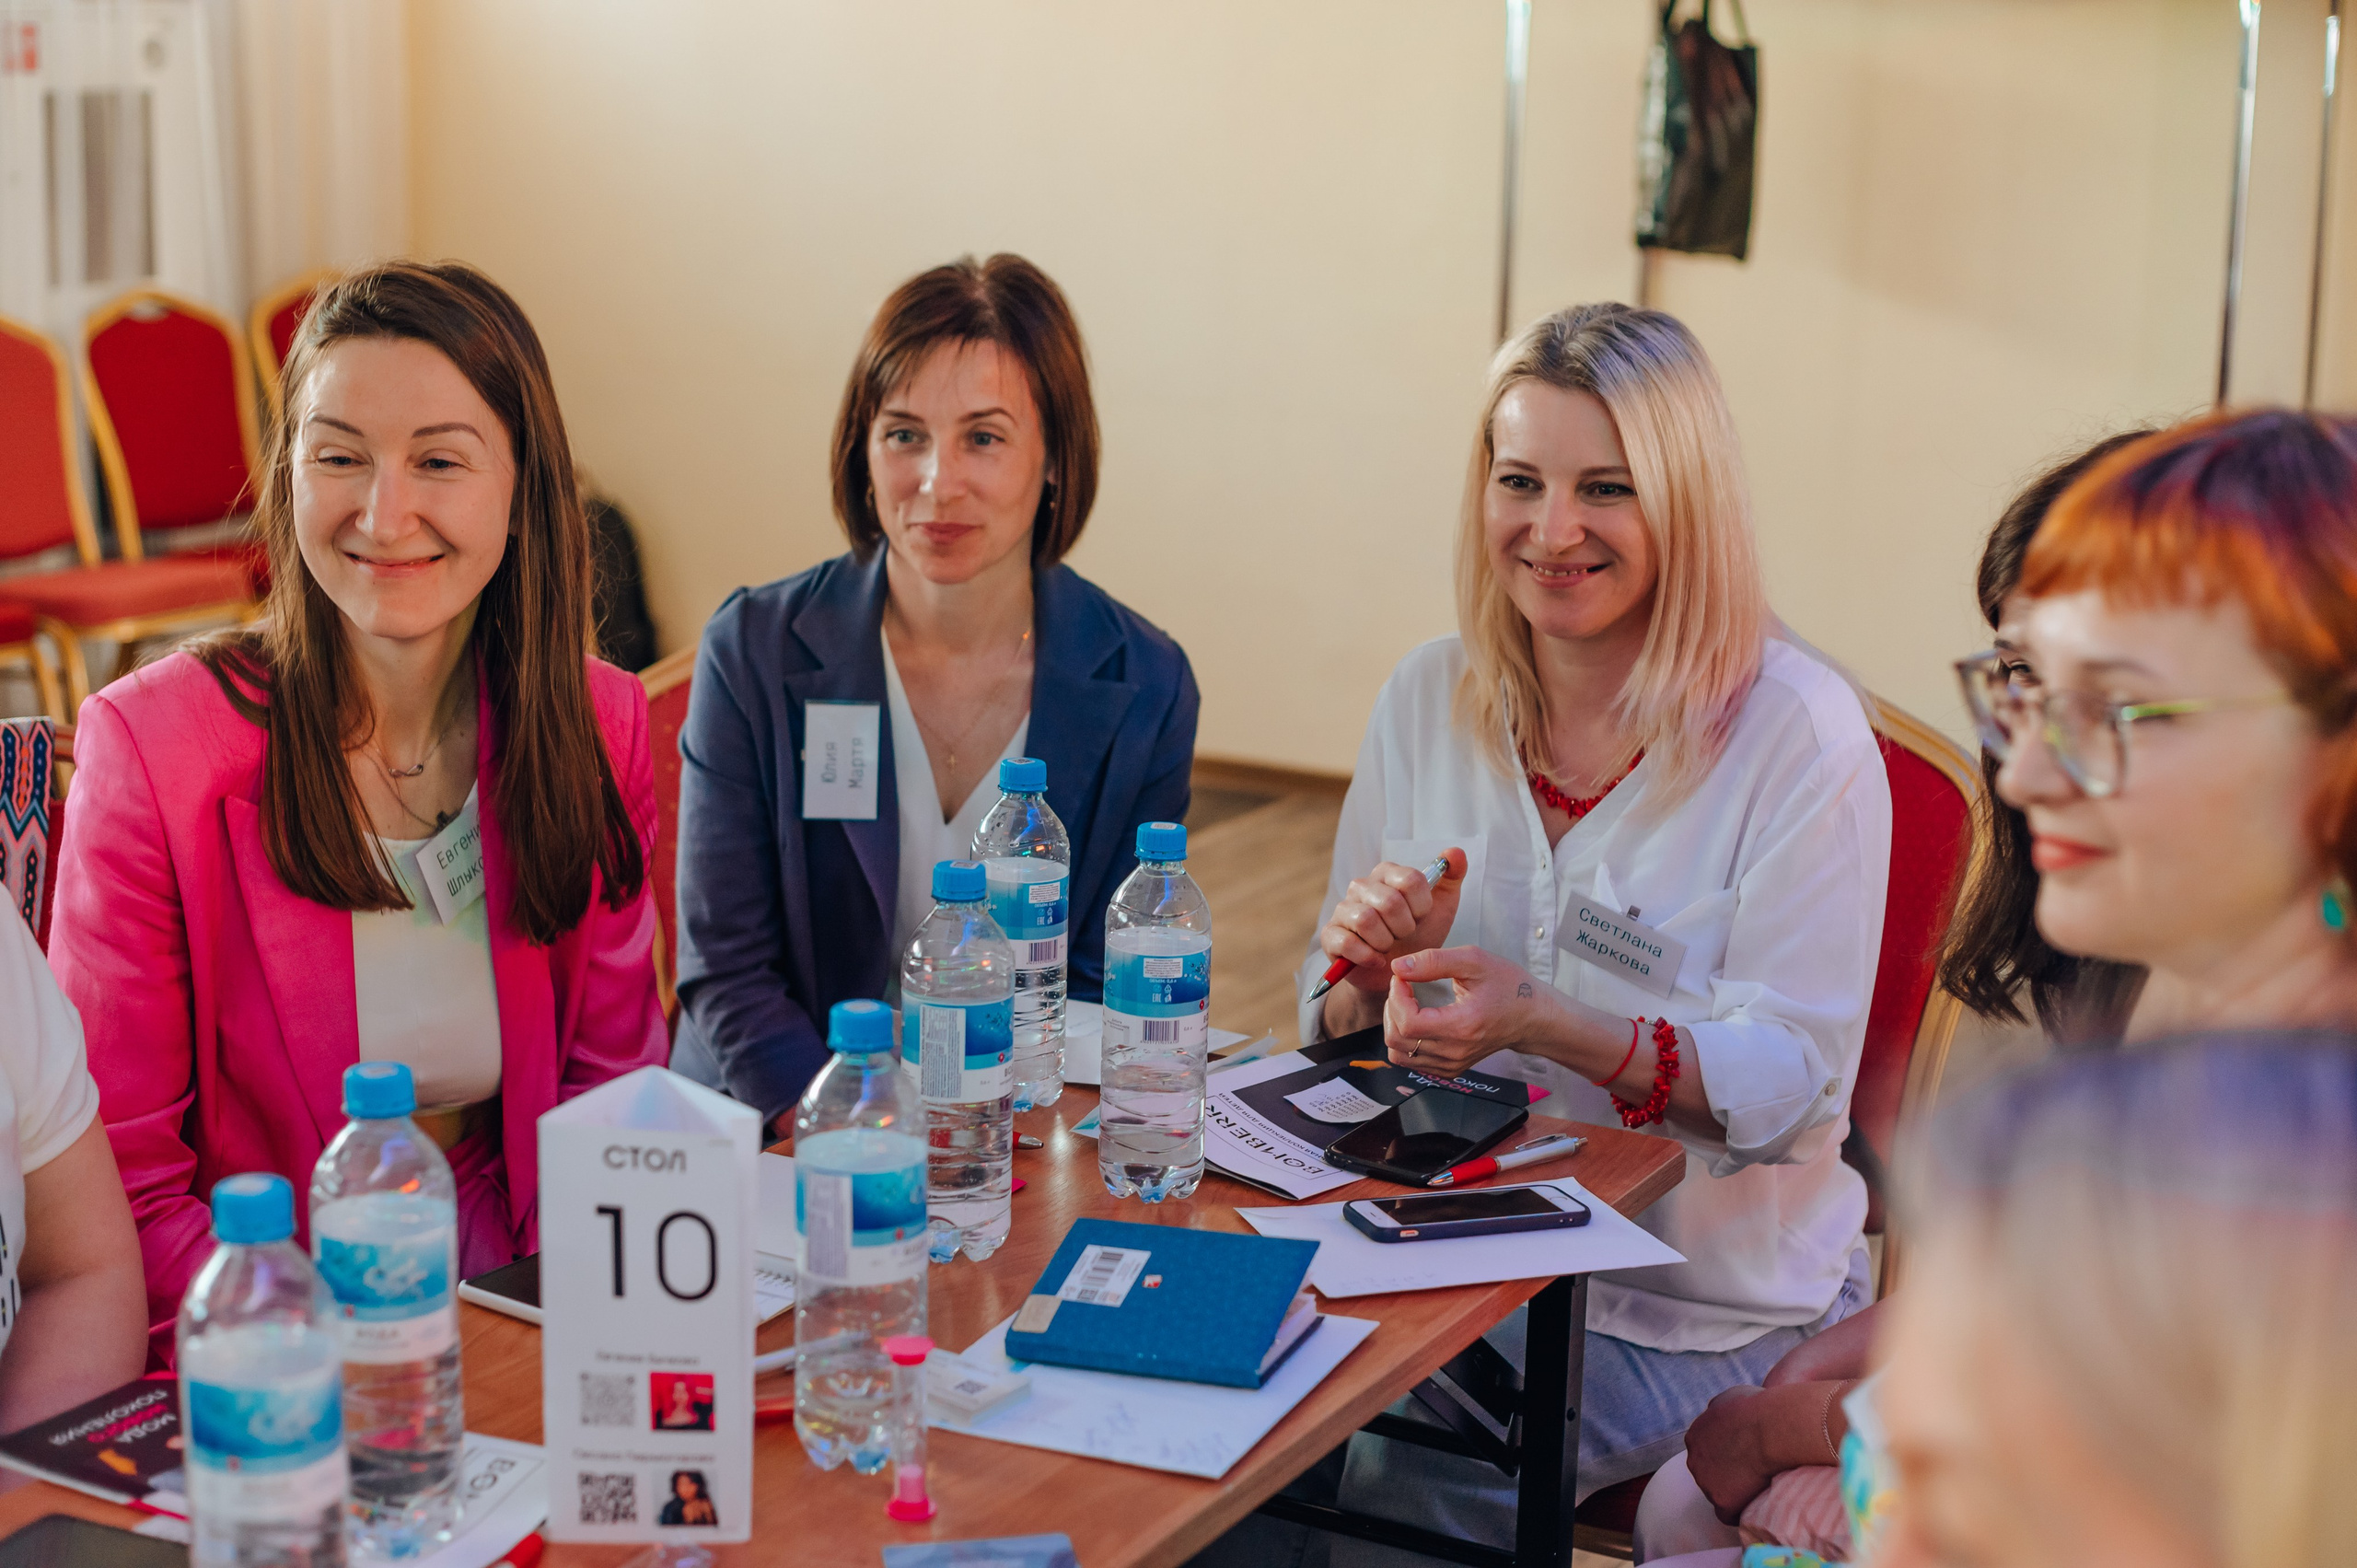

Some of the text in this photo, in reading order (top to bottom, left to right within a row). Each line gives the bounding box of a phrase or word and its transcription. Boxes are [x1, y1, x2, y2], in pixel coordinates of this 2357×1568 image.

[822, 741, 838, 784] Юлия
[436, 824, 481, 870] Евгени
[447, 856, 484, 897] Шлыко
[1579, 907, 1663, 958] Светлана
[1575, 929, 1651, 975] Жаркова
[1408, 1071, 1440, 1087] ДА
[1418, 1071, 1473, 1094] НОВО
[1454, 1077, 1501, 1093] ПОКО
[1218, 1092, 1243, 1112] ДЕТЕЙ
[1258, 1121, 1306, 1150] КОЛЛЕКЦИЯ
[602, 1144, 688, 1174] СТОЛ
[595, 1202, 719, 1304] 10
